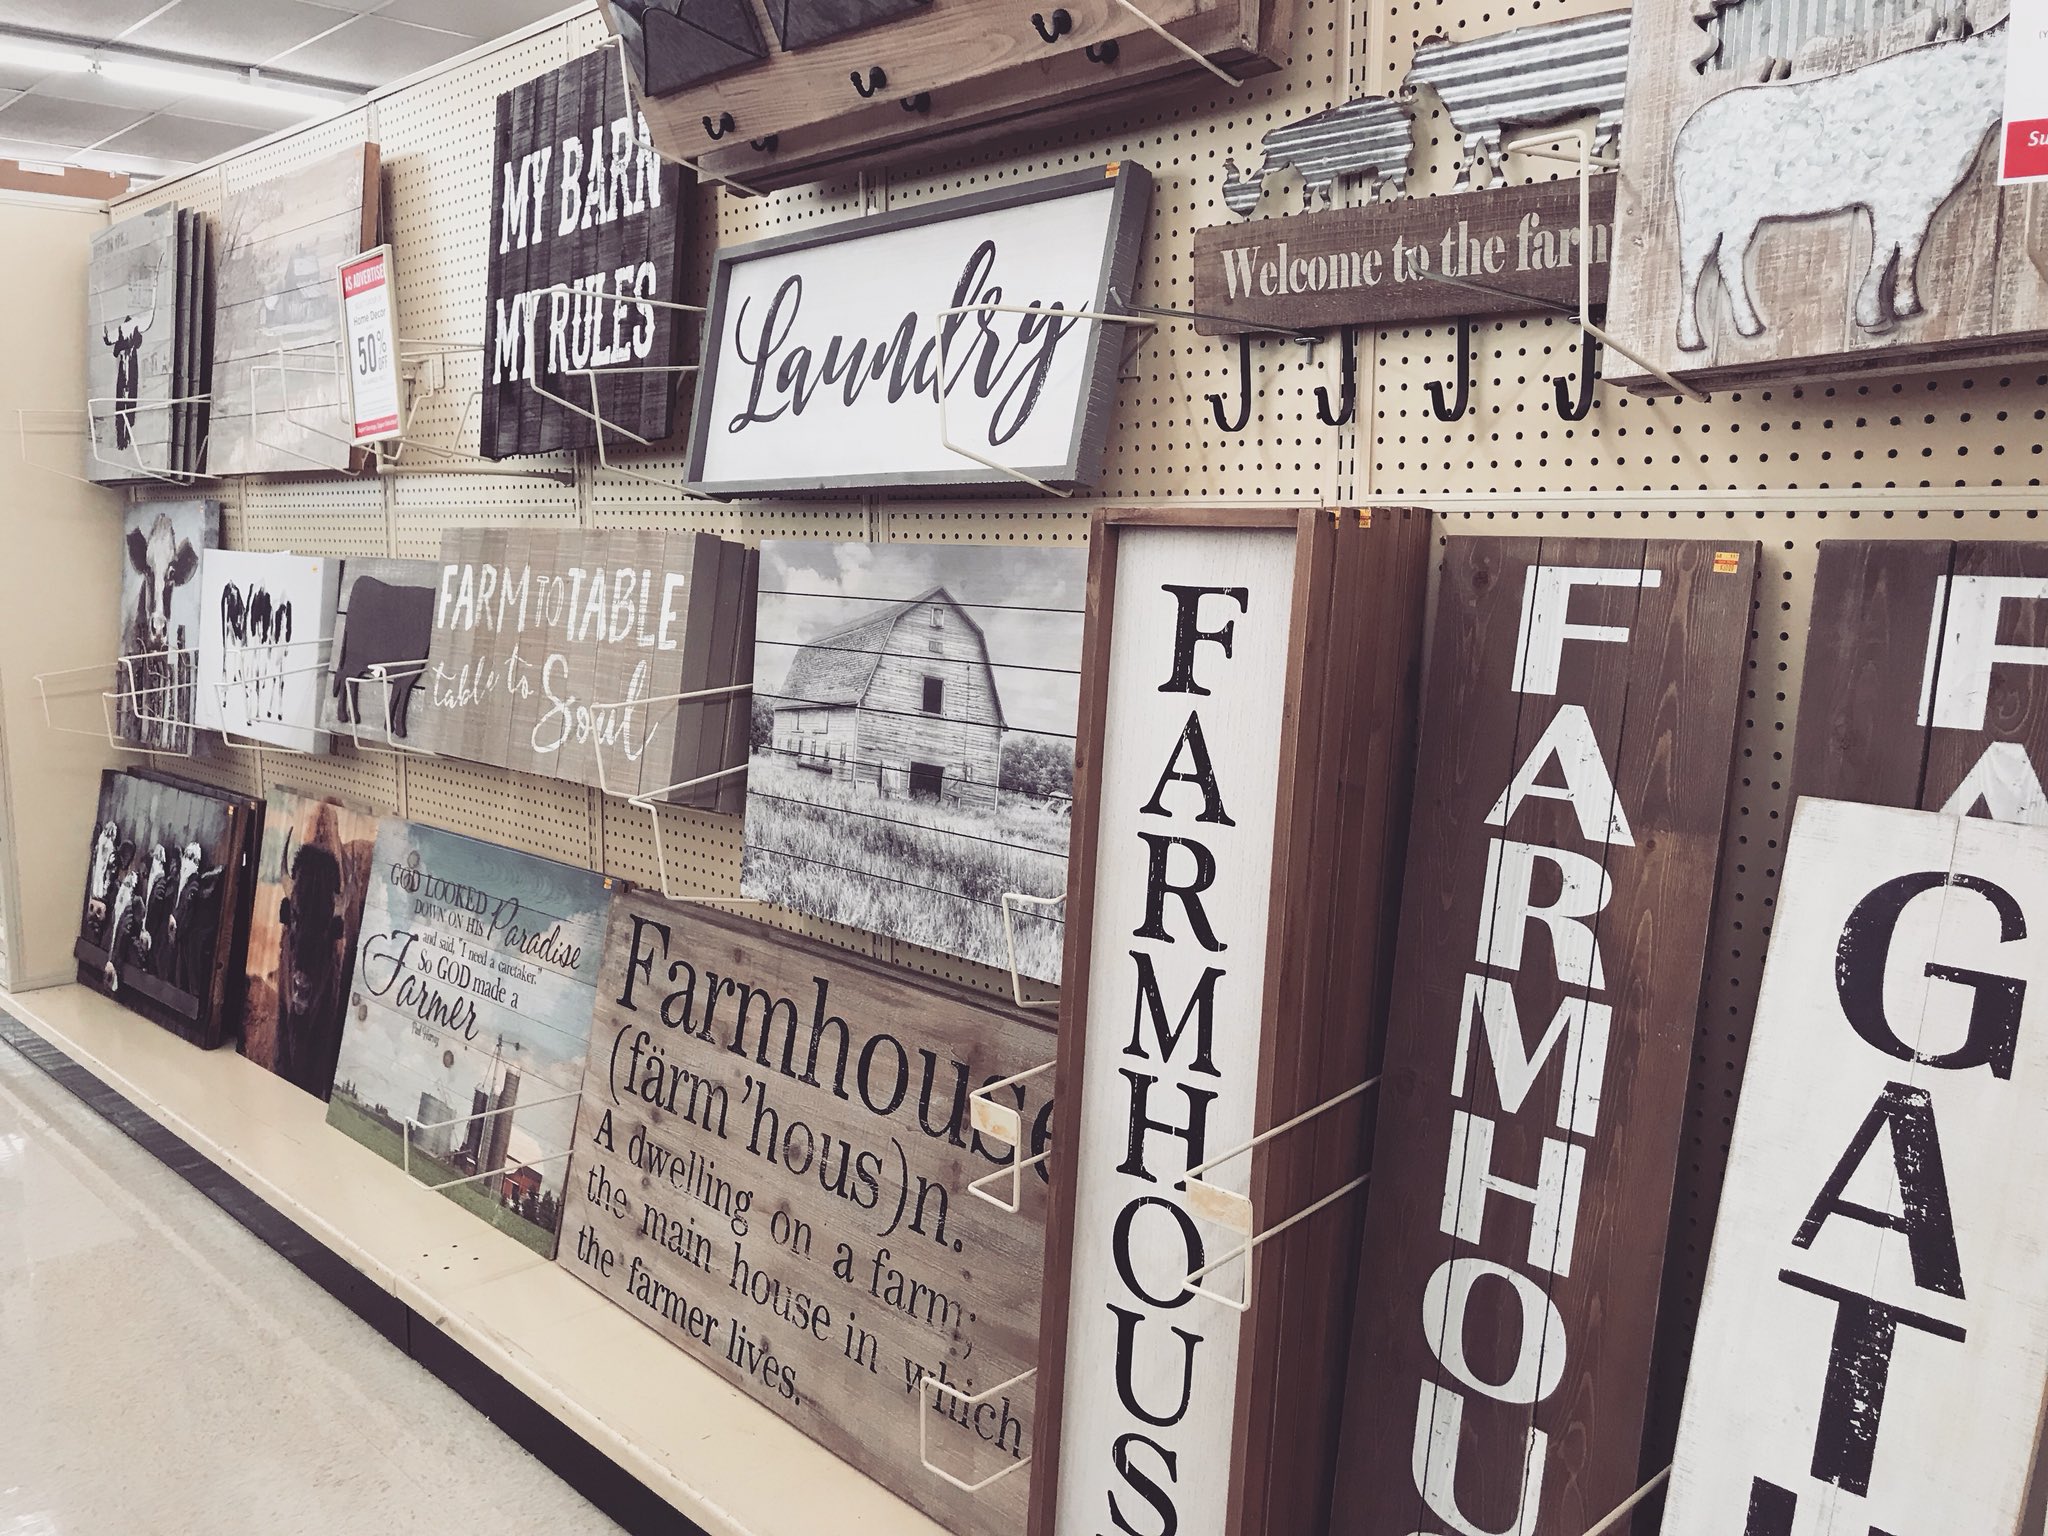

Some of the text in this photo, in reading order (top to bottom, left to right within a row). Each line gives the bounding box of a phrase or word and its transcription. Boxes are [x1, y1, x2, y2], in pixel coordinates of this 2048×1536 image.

[500, 111, 662, 254] MY BARN
[344, 275, 353, 292] AS
[1220, 243, 1383, 299] Welcome
[1391, 235, 1431, 281] to
[1439, 220, 1505, 277] the
[353, 314, 369, 326] Home
[493, 261, 657, 385] MY RULES
[728, 240, 1090, 446] Laundry
[437, 563, 686, 651] FARM TO TABLE
[432, 643, 659, 761] table to Soul
[390, 863, 488, 915] GOD LOOKED
[414, 897, 581, 971] DOWN ON HIS Paradise
[362, 929, 480, 1041] Farmer
[417, 948, 519, 1010] So GOD made a
[422, 931, 437, 947] and
[438, 935, 455, 957] said,
[468, 947, 488, 967] need
[489, 957, 496, 970] a
[1096, 583, 1249, 1536] FARMHOUS
[1403, 564, 1661, 1536] FARMHOU
[593, 1108, 977, 1359] A dwelling on a farm;
[1744, 869, 2028, 1536] GAT
[577, 1224, 801, 1406] the farmer lives.
[587, 1164, 1022, 1460] the main house in which
